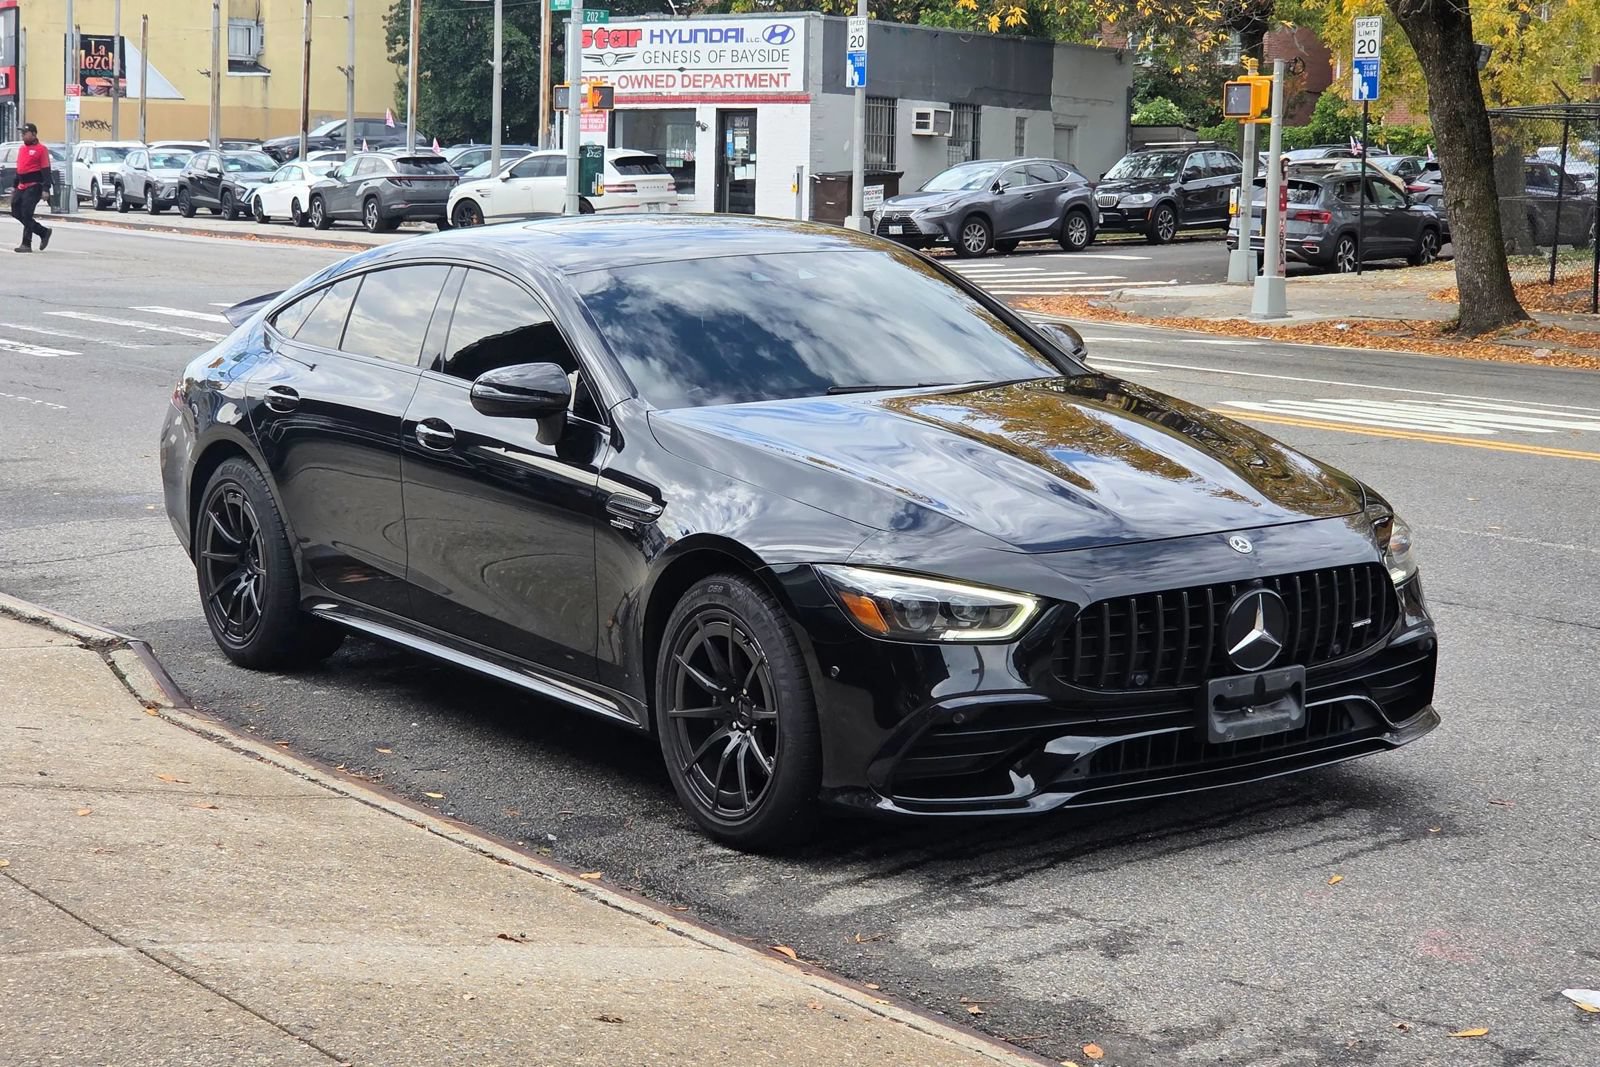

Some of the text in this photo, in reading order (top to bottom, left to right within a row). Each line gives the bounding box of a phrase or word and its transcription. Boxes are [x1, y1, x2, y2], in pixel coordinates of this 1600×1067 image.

[586, 11, 599, 22] 202
[1357, 21, 1379, 29] SPEED
[650, 28, 744, 44] HYUNDAI
[850, 35, 865, 48] 20
[91, 40, 106, 56] La
[1357, 39, 1377, 54] 20
[76, 49, 116, 71] ezcl
[642, 48, 790, 64] GENESIS OF BAYSIDE
[681, 73, 791, 89] DEPARTMENT
